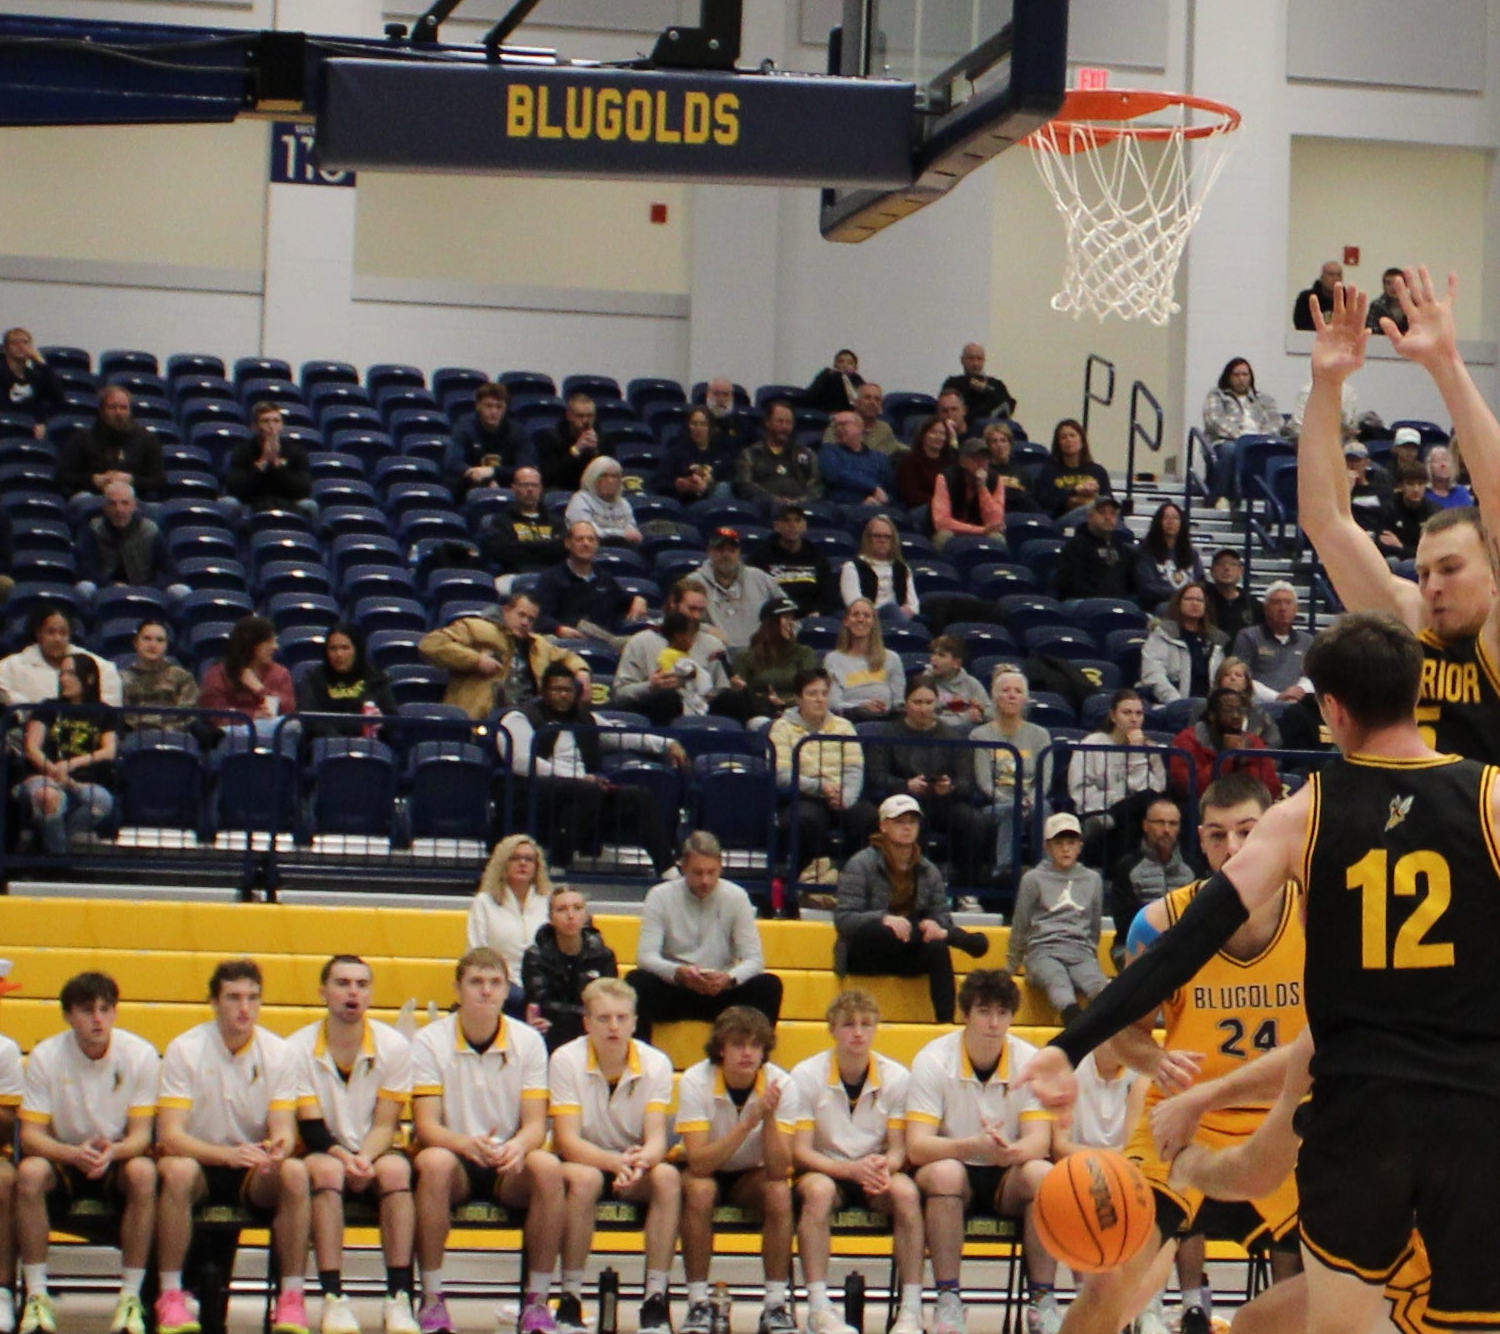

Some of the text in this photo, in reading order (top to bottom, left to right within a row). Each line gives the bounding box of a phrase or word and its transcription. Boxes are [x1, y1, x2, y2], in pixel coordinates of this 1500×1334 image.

[506, 83, 741, 146] BLUGOLDS
[1420, 658, 1482, 705] RIOR
[1346, 848, 1455, 969] 12
[1194, 981, 1300, 1009] BLUGOLDS
[1216, 1018, 1278, 1058] 24
